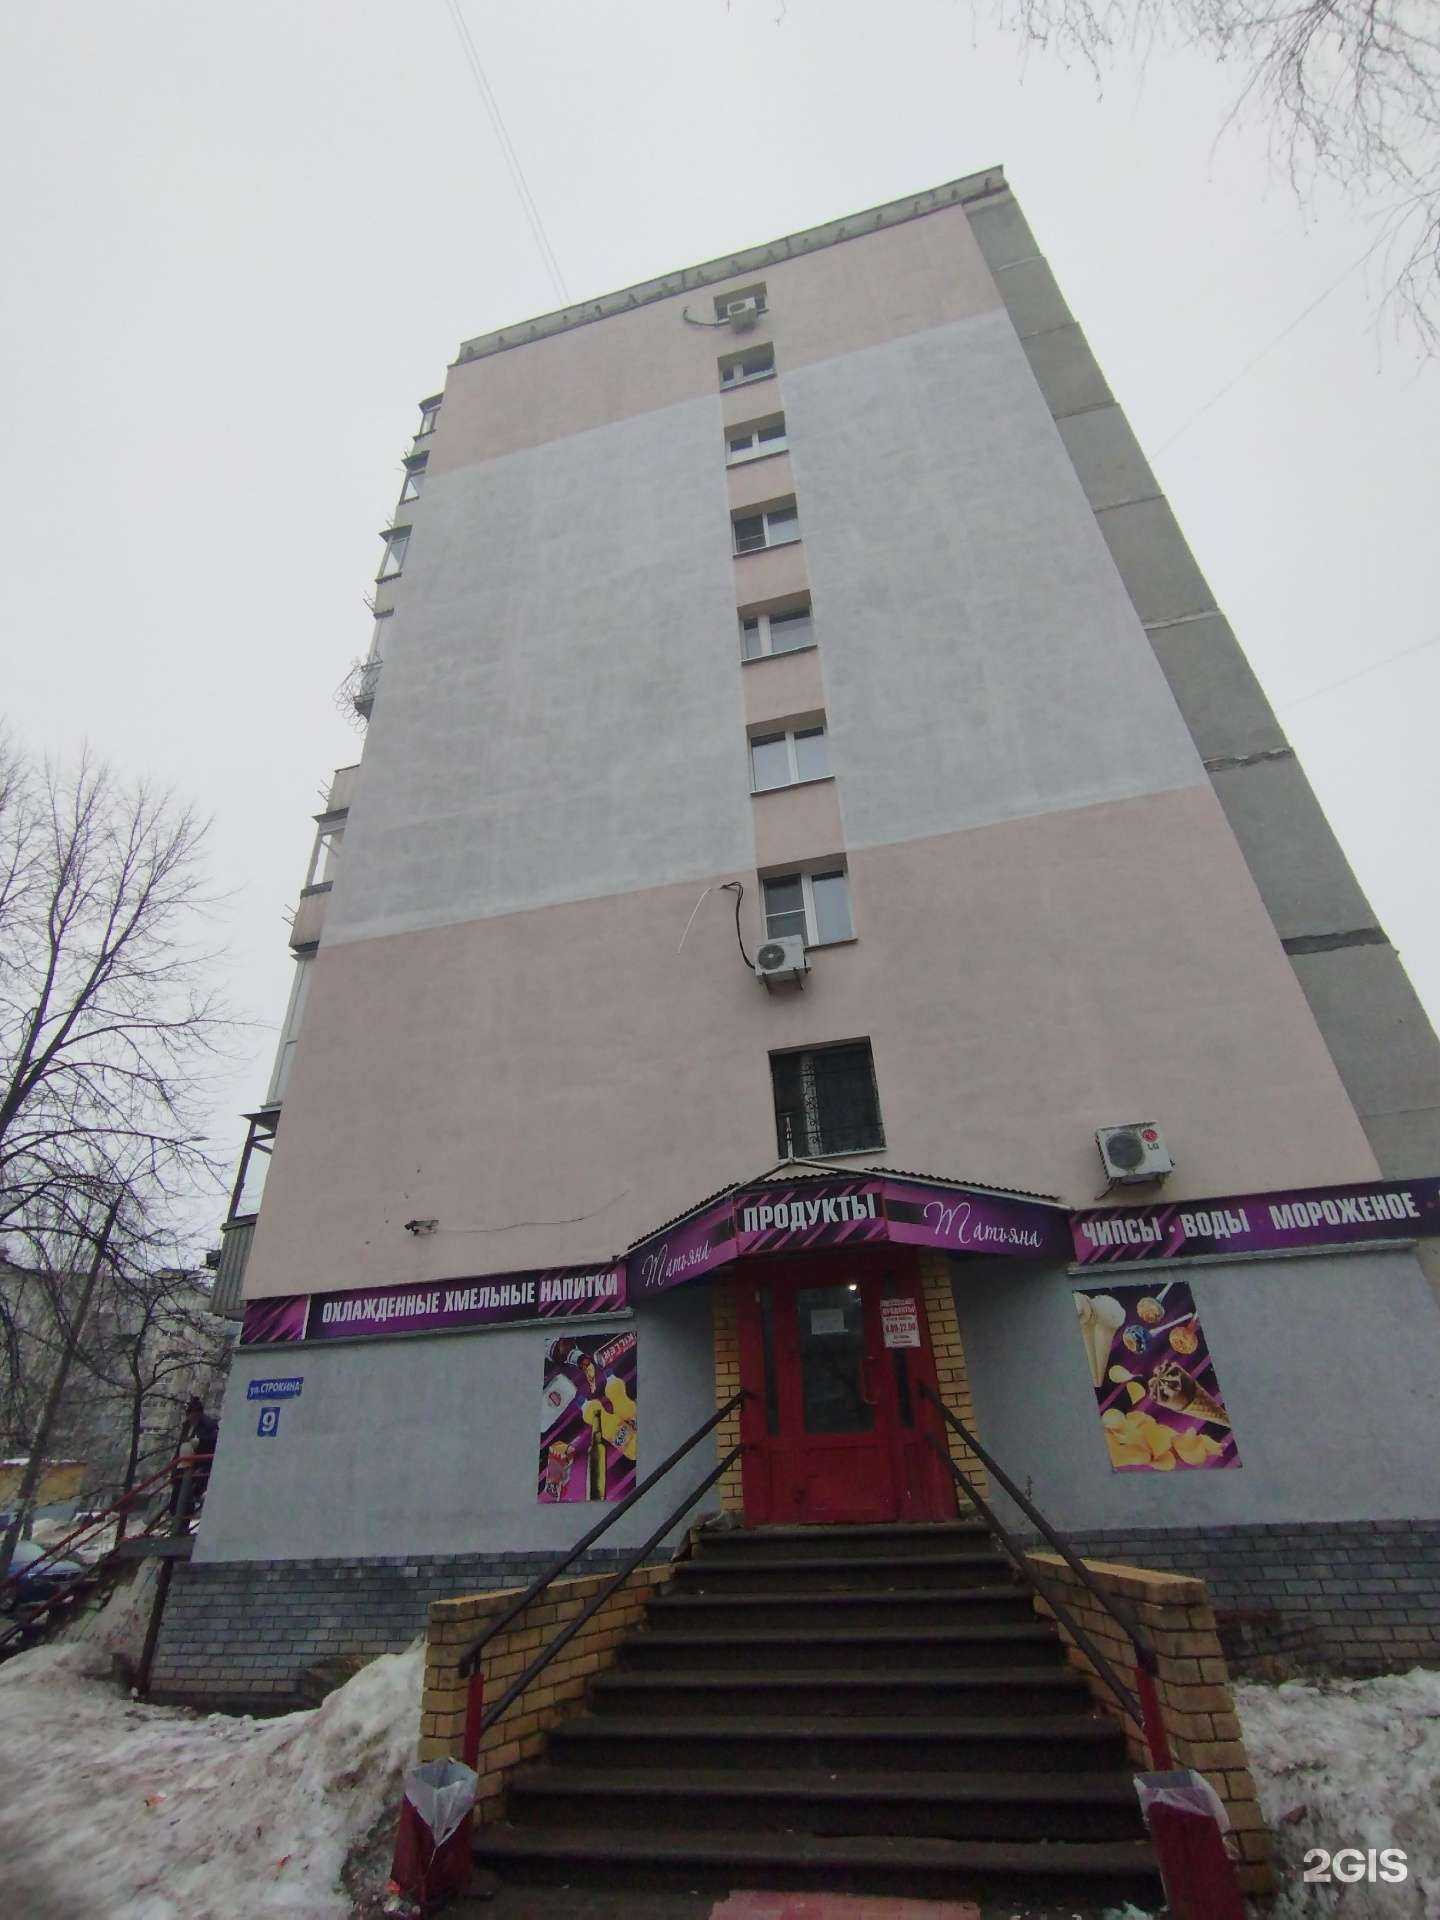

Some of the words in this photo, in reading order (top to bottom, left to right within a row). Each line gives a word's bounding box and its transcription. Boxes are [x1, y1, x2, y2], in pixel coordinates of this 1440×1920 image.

[743, 1193, 876, 1233] ПРОДУКТЫ
[922, 1201, 1044, 1249] Татьяна
[1081, 1215, 1162, 1247] ЧИПСЫ
[1179, 1208, 1250, 1239] ВОДЫ
[1268, 1191, 1421, 1231] МОРОЖЕНОЕ
[640, 1239, 711, 1288] Татьяна
[322, 1291, 439, 1323] ОХЛАЖДЕННЫЕ
[444, 1281, 535, 1313] ХМЕЛЬНЫЕ
[540, 1273, 618, 1302] НАПИТКИ
[262, 1411, 276, 1432] 9
